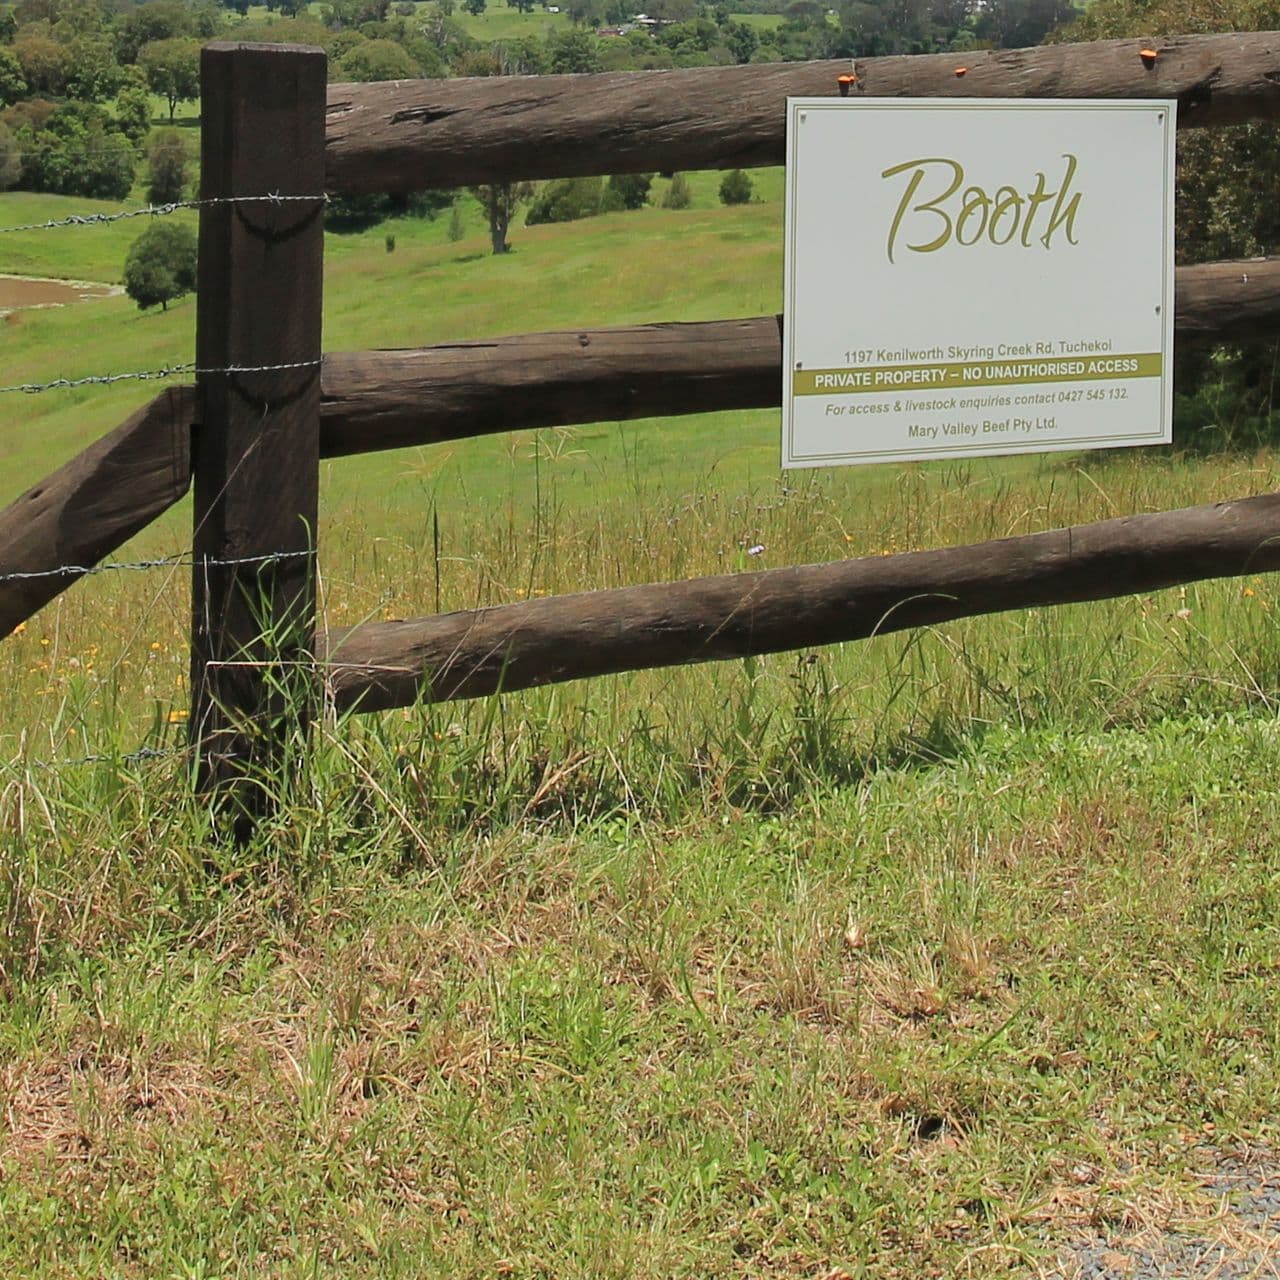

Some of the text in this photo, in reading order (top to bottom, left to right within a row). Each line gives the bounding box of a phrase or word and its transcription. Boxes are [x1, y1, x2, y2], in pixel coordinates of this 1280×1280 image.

[881, 154, 1082, 265] Booth
[844, 350, 873, 363] 1197
[876, 346, 944, 361] Kenilworth
[948, 345, 994, 361] Skyring
[998, 343, 1032, 356] Creek
[1036, 342, 1055, 355] Rd,
[815, 372, 872, 388] PRIVATE
[875, 368, 947, 384] PROPERTY
[963, 367, 982, 380] NO
[985, 362, 1085, 378] UNAUTHORISED
[1088, 359, 1139, 373] ACCESS
[825, 404, 846, 416] For
[848, 403, 890, 415] access
[893, 400, 902, 412] &
[905, 398, 956, 411] livestock
[959, 394, 1011, 410] enquiries
[1014, 392, 1055, 405] contact
[1058, 390, 1083, 402] 0427
[1087, 389, 1105, 400] 545
[908, 417, 1057, 439] Mary Valley Beef Pty Ltd.
